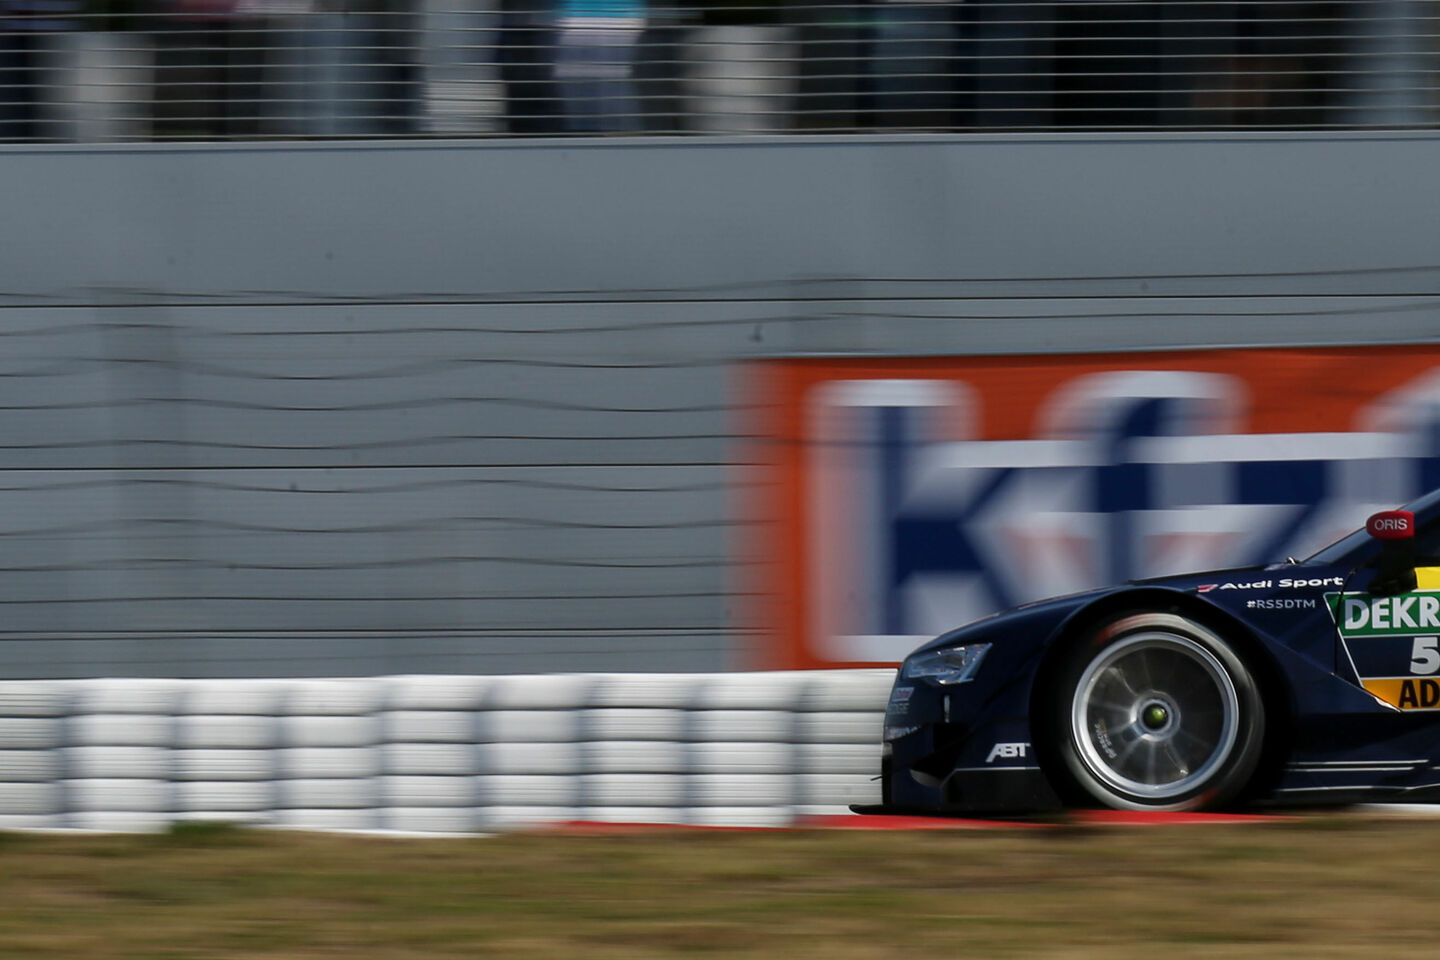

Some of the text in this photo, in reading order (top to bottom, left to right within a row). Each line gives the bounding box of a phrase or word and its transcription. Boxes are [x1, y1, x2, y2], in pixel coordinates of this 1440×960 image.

[1374, 518, 1408, 531] ORIS
[1220, 577, 1344, 590] Audi Sport
[1410, 637, 1440, 675] 5
[985, 742, 1031, 763] ABT
